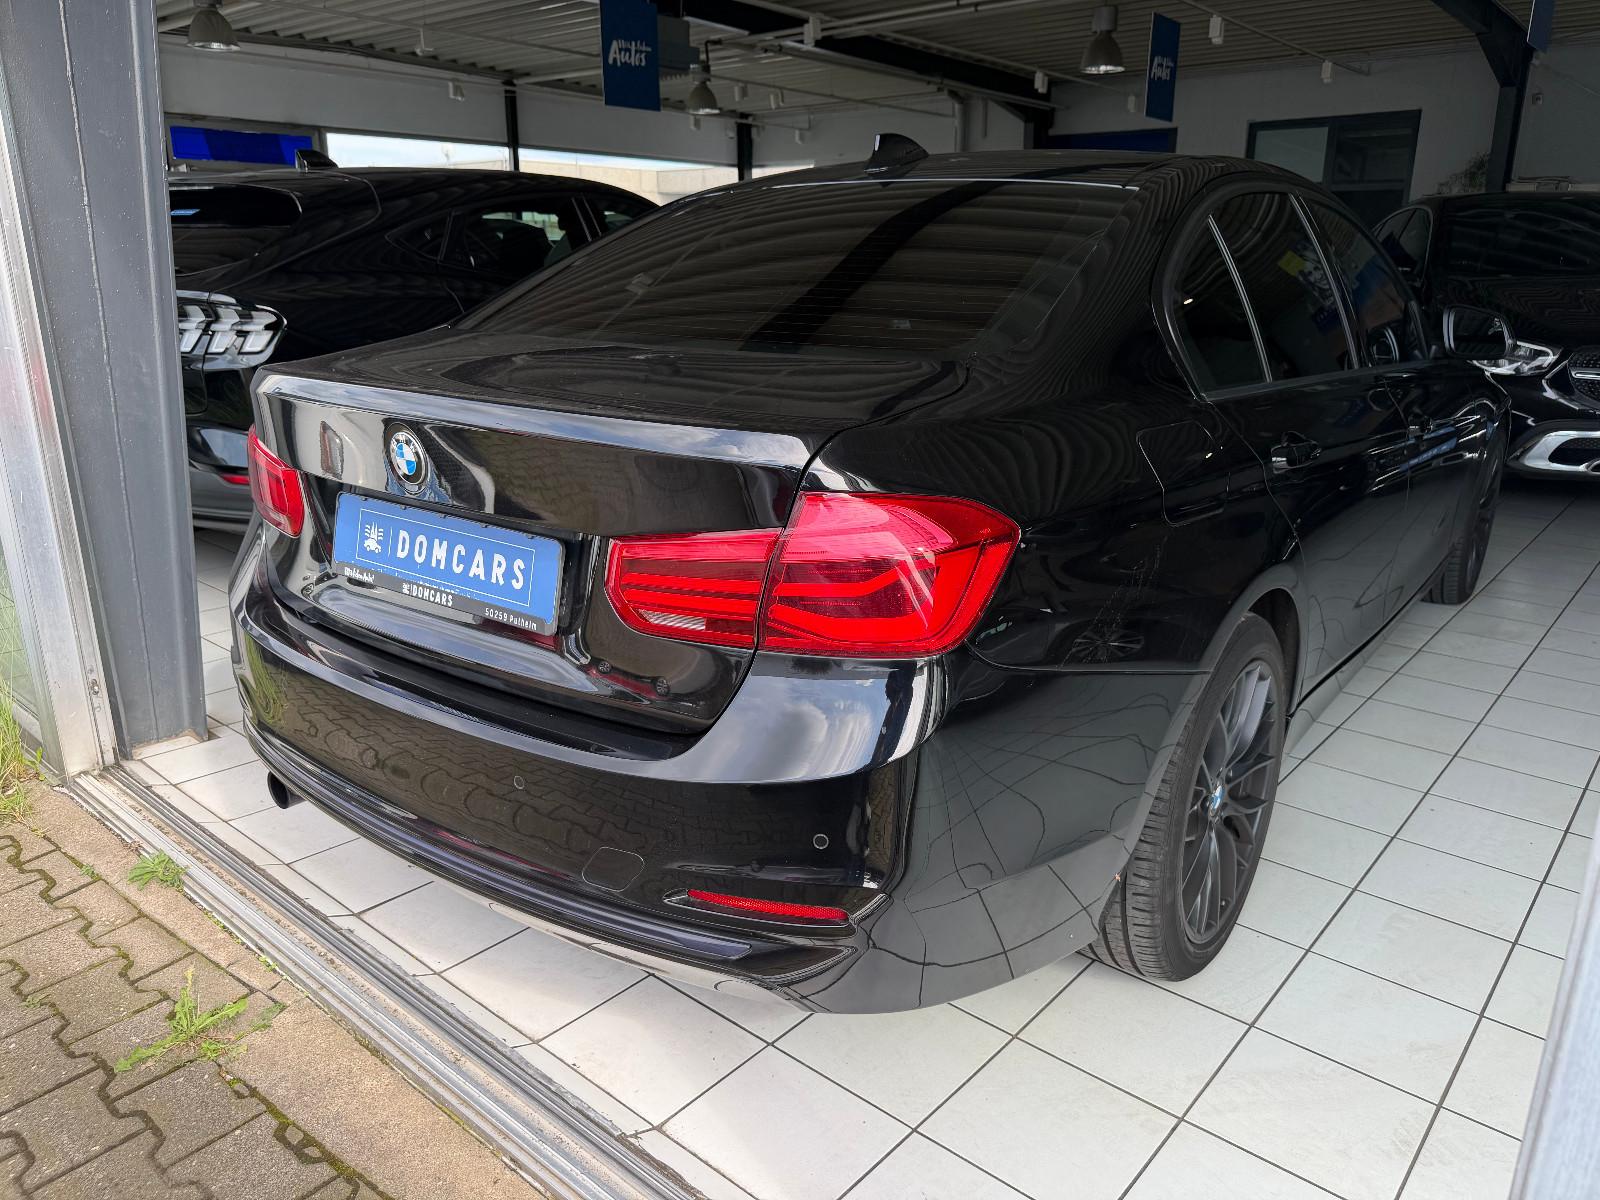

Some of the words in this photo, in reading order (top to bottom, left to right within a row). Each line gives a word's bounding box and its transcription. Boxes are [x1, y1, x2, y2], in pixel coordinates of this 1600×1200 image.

[608, 40, 646, 67] Autos
[397, 529, 525, 590] DOMCARS
[412, 584, 453, 607] DOMCARS
[485, 607, 508, 622] 50259
[509, 615, 537, 631] Pulheim
